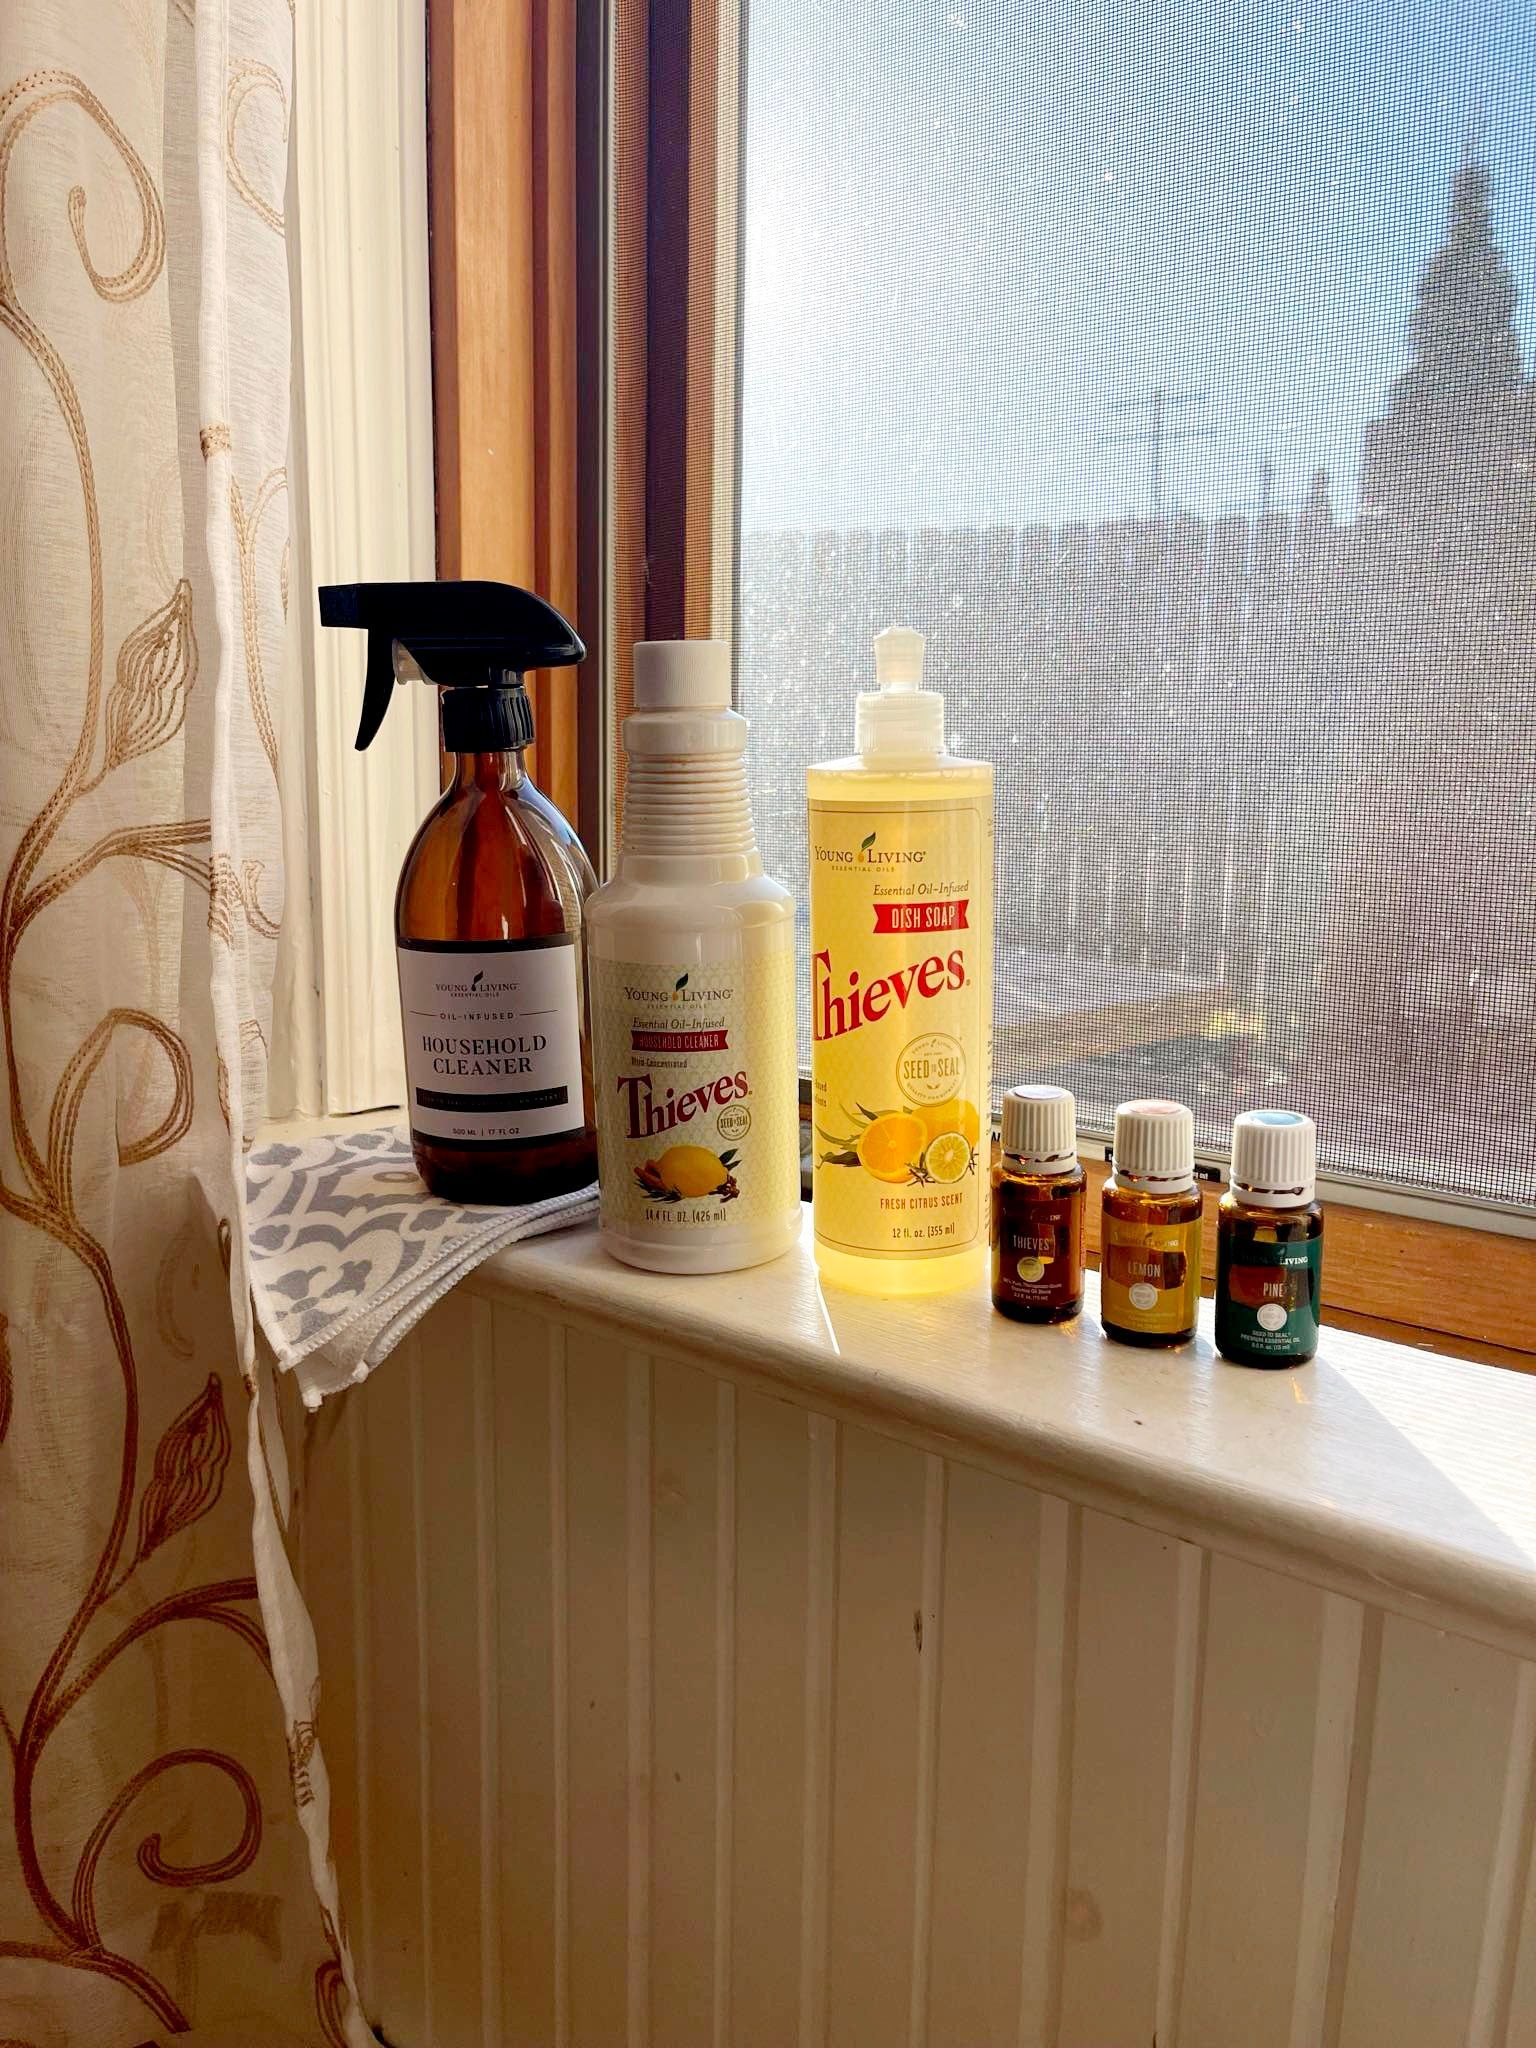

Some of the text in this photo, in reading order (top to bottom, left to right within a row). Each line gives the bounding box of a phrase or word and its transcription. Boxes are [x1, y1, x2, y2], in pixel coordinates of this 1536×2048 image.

[814, 846, 924, 864] YOUNG LIVING
[873, 880, 969, 897] Essential Oil-Infused
[891, 905, 956, 929] DISH SOAP
[435, 983, 517, 992] YOUNG LIVING
[624, 987, 731, 1002] YOUNG LIVING
[440, 1012, 514, 1021] OIL-INFUSED
[632, 1016, 725, 1031] Essential Oil-Infused
[422, 1035, 547, 1055] HOUSEHOLD
[639, 1034, 719, 1049] HOUSEHOLD CLEANER
[433, 1057, 533, 1076] CLEANER
[903, 1060, 930, 1080] SEED
[938, 1057, 960, 1077] SEAL
[616, 1070, 749, 1139] Thieves
[509, 1127, 520, 1135] OZ
[720, 1117, 734, 1129] SEED
[880, 1192, 963, 1210] FRESH CITRUS SCENT
[692, 1209, 711, 1223] (426
[713, 1208, 727, 1222] ml)
[892, 1228, 901, 1239] 12
[914, 1228, 925, 1239] oz.
[927, 1223, 943, 1238] (355
[945, 1221, 955, 1236] ml)
[1012, 1234, 1050, 1251] THIEVES
[1280, 1256, 1308, 1265] LIVING
[1127, 1261, 1161, 1278] LEMON
[1263, 1282, 1285, 1297] PINE
